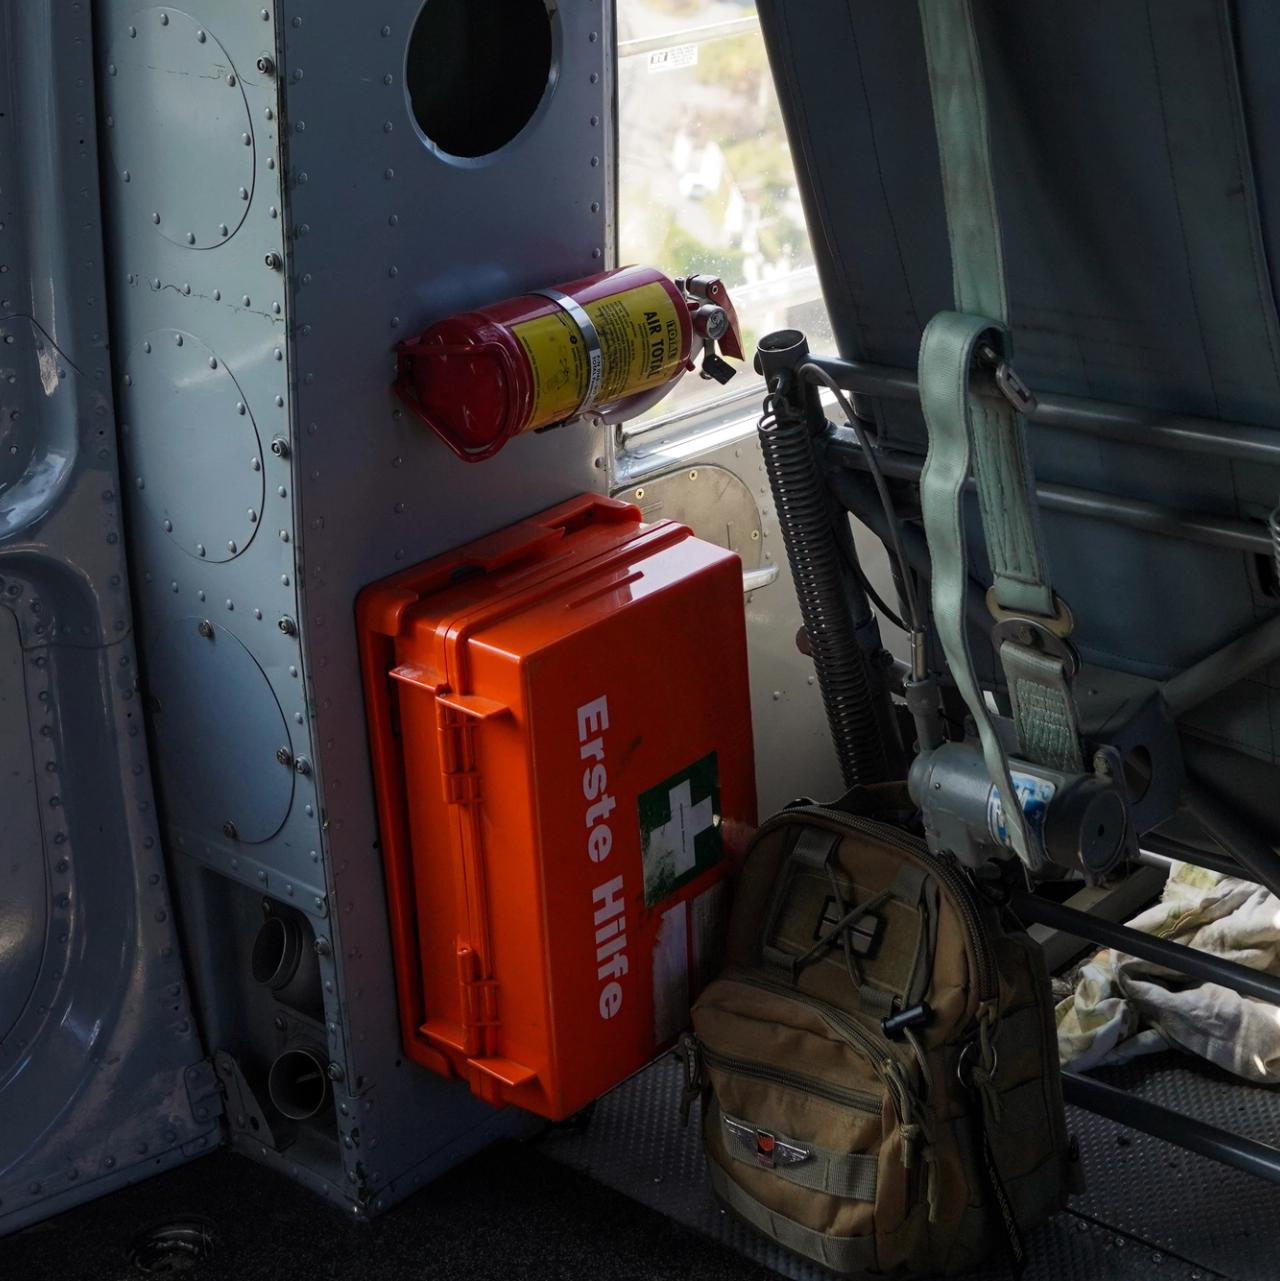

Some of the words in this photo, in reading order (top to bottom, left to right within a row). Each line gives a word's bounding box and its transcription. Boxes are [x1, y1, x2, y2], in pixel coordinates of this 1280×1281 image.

[644, 311, 662, 335] AIR
[646, 339, 665, 379] TOTAL
[576, 694, 618, 864] Erste
[591, 874, 632, 1022] Hilfe
